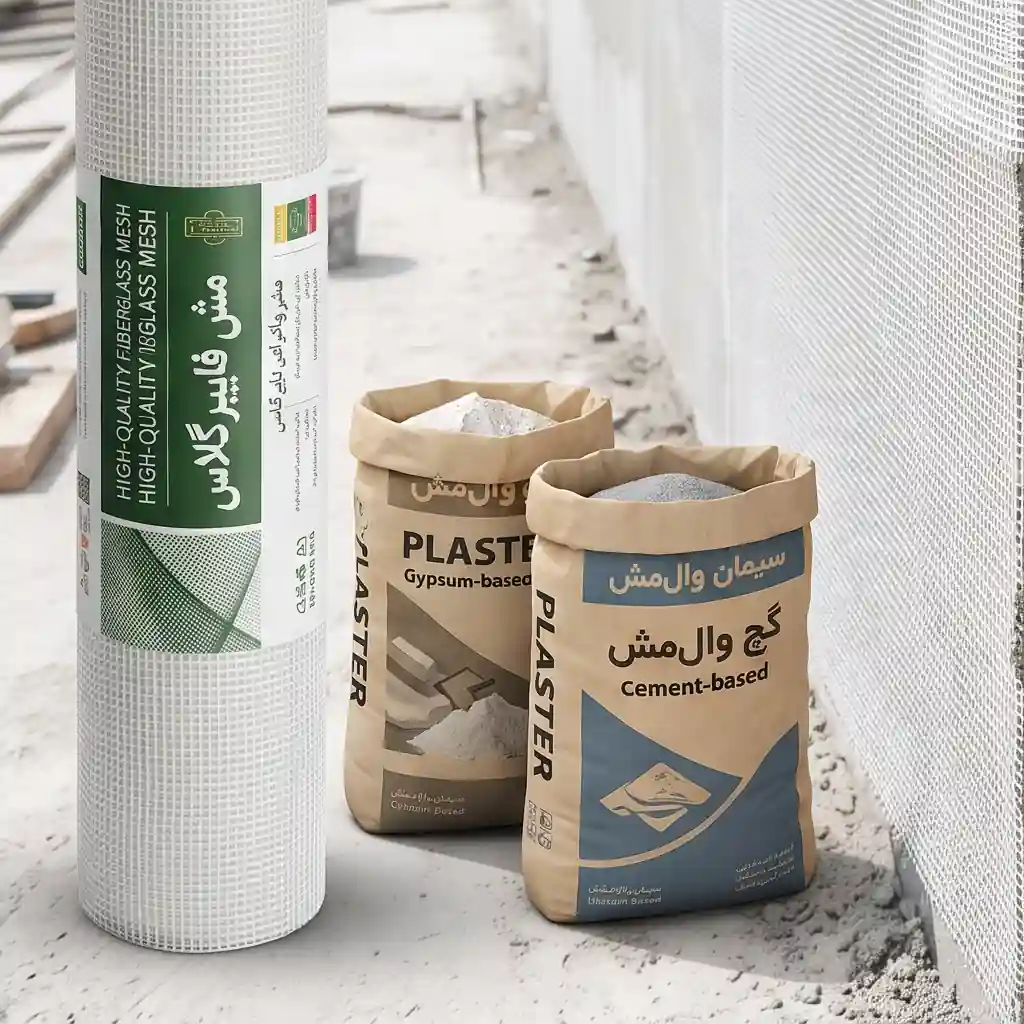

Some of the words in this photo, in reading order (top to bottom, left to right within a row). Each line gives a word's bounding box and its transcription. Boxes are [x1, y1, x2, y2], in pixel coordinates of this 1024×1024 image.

[115, 203, 131, 254] MESH
[138, 208, 156, 267] MESH
[190, 274, 242, 340] مش
[138, 358, 160, 505] HIGH-QUALITY
[404, 568, 532, 589] Gypsum-based
[713, 551, 786, 588] سیمان
[533, 589, 556, 782] PLASTER
[621, 661, 769, 697] Cement-based
